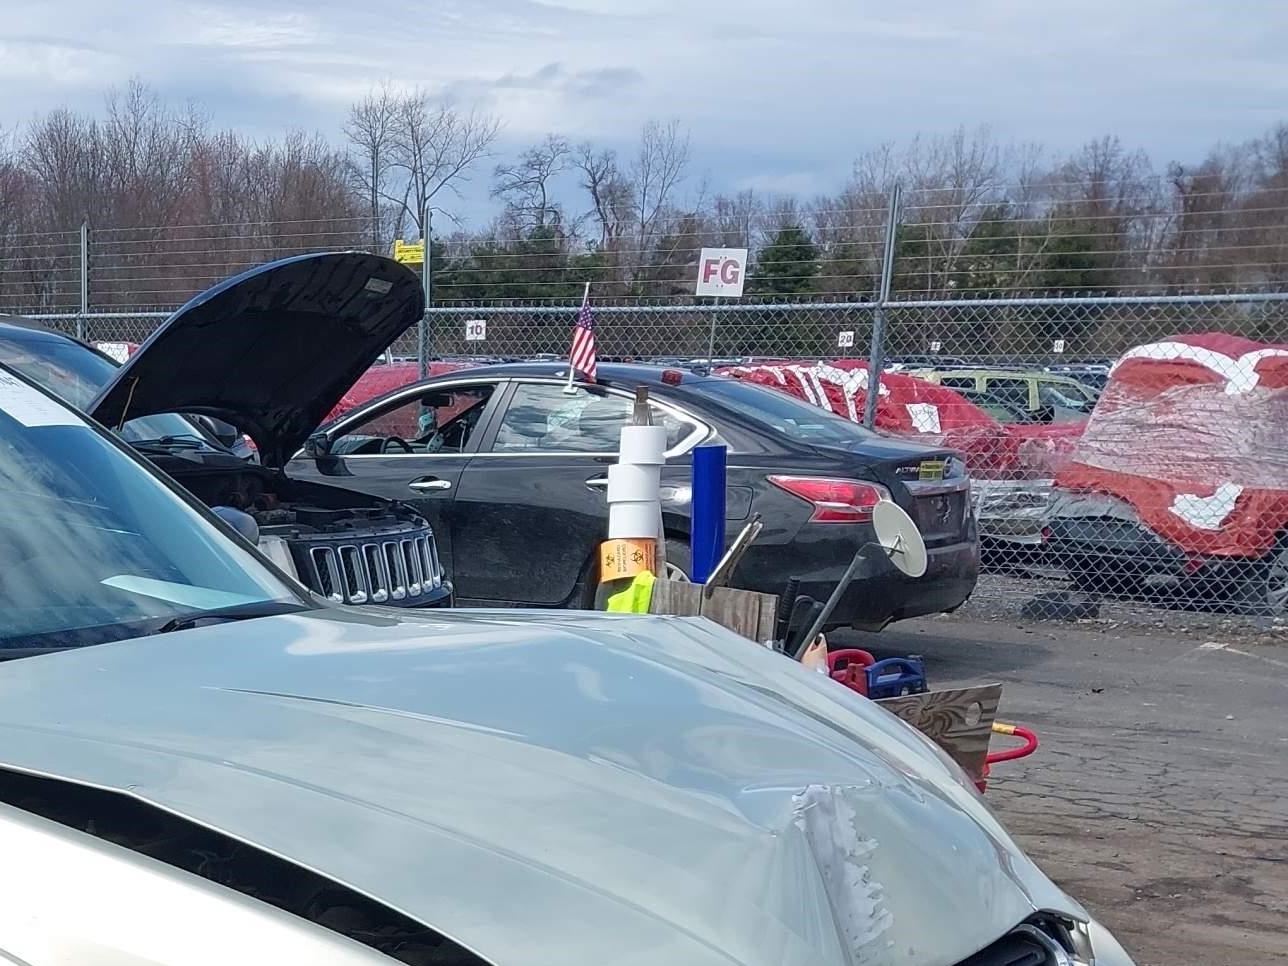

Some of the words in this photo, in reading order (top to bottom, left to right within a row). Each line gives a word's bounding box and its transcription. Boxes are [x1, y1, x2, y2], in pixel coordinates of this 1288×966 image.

[703, 259, 740, 285] FG
[468, 325, 482, 335] 10
[840, 335, 852, 344] 20
